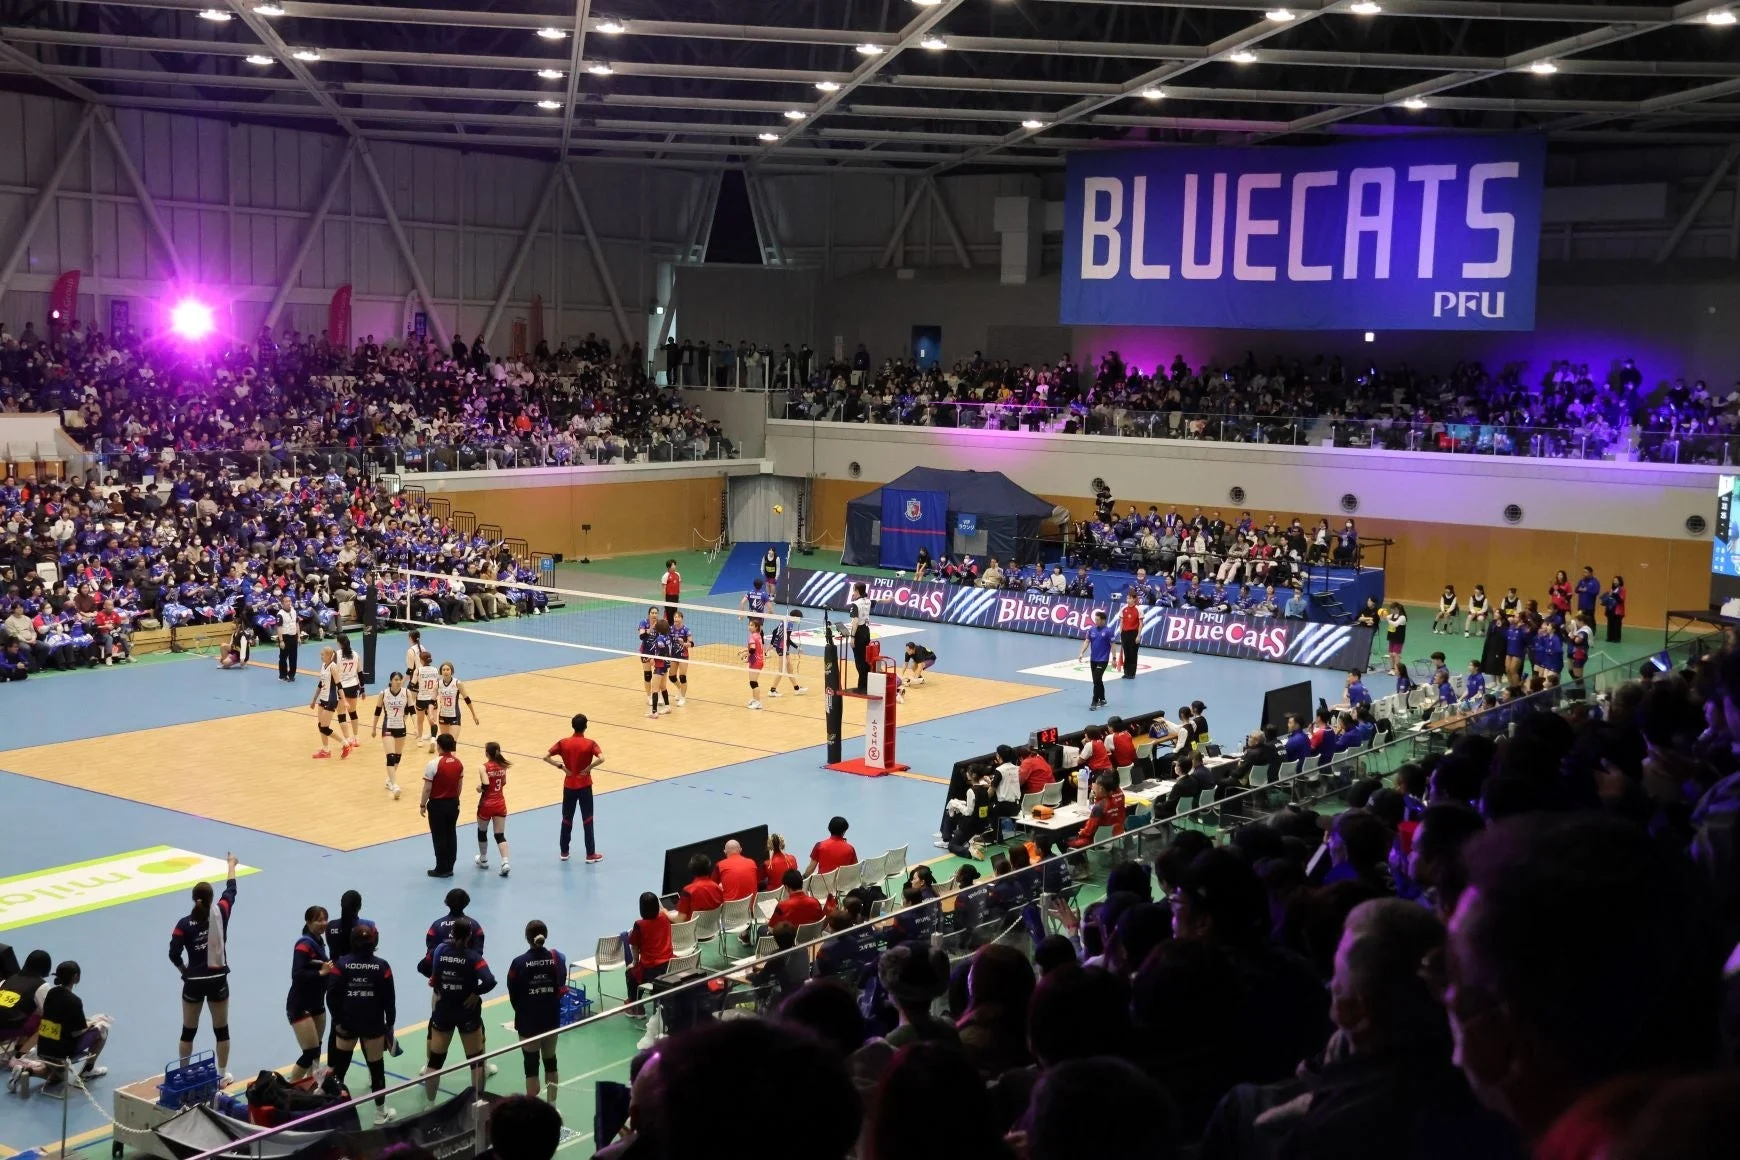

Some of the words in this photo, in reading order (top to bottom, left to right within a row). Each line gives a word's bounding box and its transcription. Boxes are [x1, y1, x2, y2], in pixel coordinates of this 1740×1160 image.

[1081, 161, 1520, 282] BLUECATS
[1432, 291, 1505, 318] PFU
[874, 578, 894, 588] PFU
[1028, 593, 1050, 605] PFU
[1199, 611, 1224, 623] PFU
[342, 662, 354, 673] 77
[424, 680, 434, 689] 10
[393, 707, 399, 718] 7
[345, 962, 380, 971] KODAMA
[525, 959, 555, 968] HIROTA
